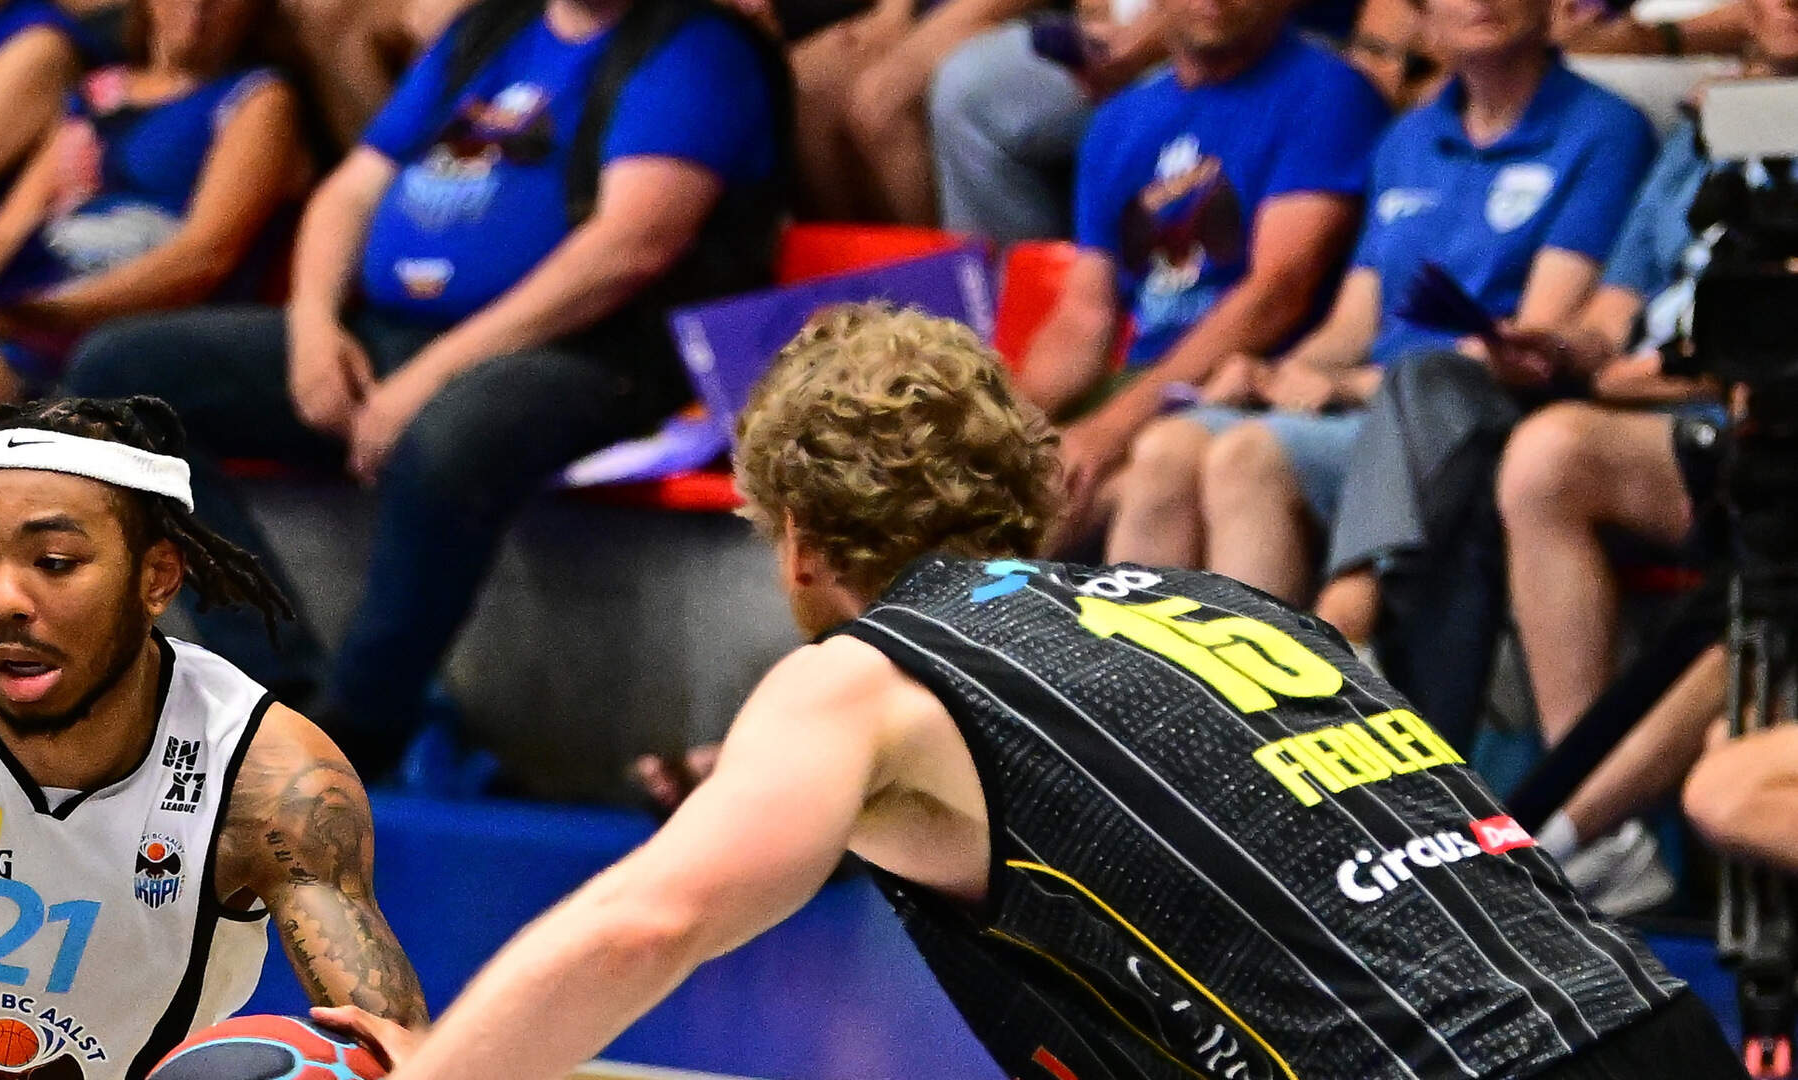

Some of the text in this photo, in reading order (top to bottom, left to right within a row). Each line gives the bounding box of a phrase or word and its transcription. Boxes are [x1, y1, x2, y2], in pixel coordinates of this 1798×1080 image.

[1074, 596, 1345, 714] 15
[1252, 708, 1467, 808] FIEDLER
[160, 801, 197, 814] LEAGUE
[1337, 831, 1482, 902] Circus
[2, 993, 35, 1013] BC
[38, 1007, 106, 1062] AALST
